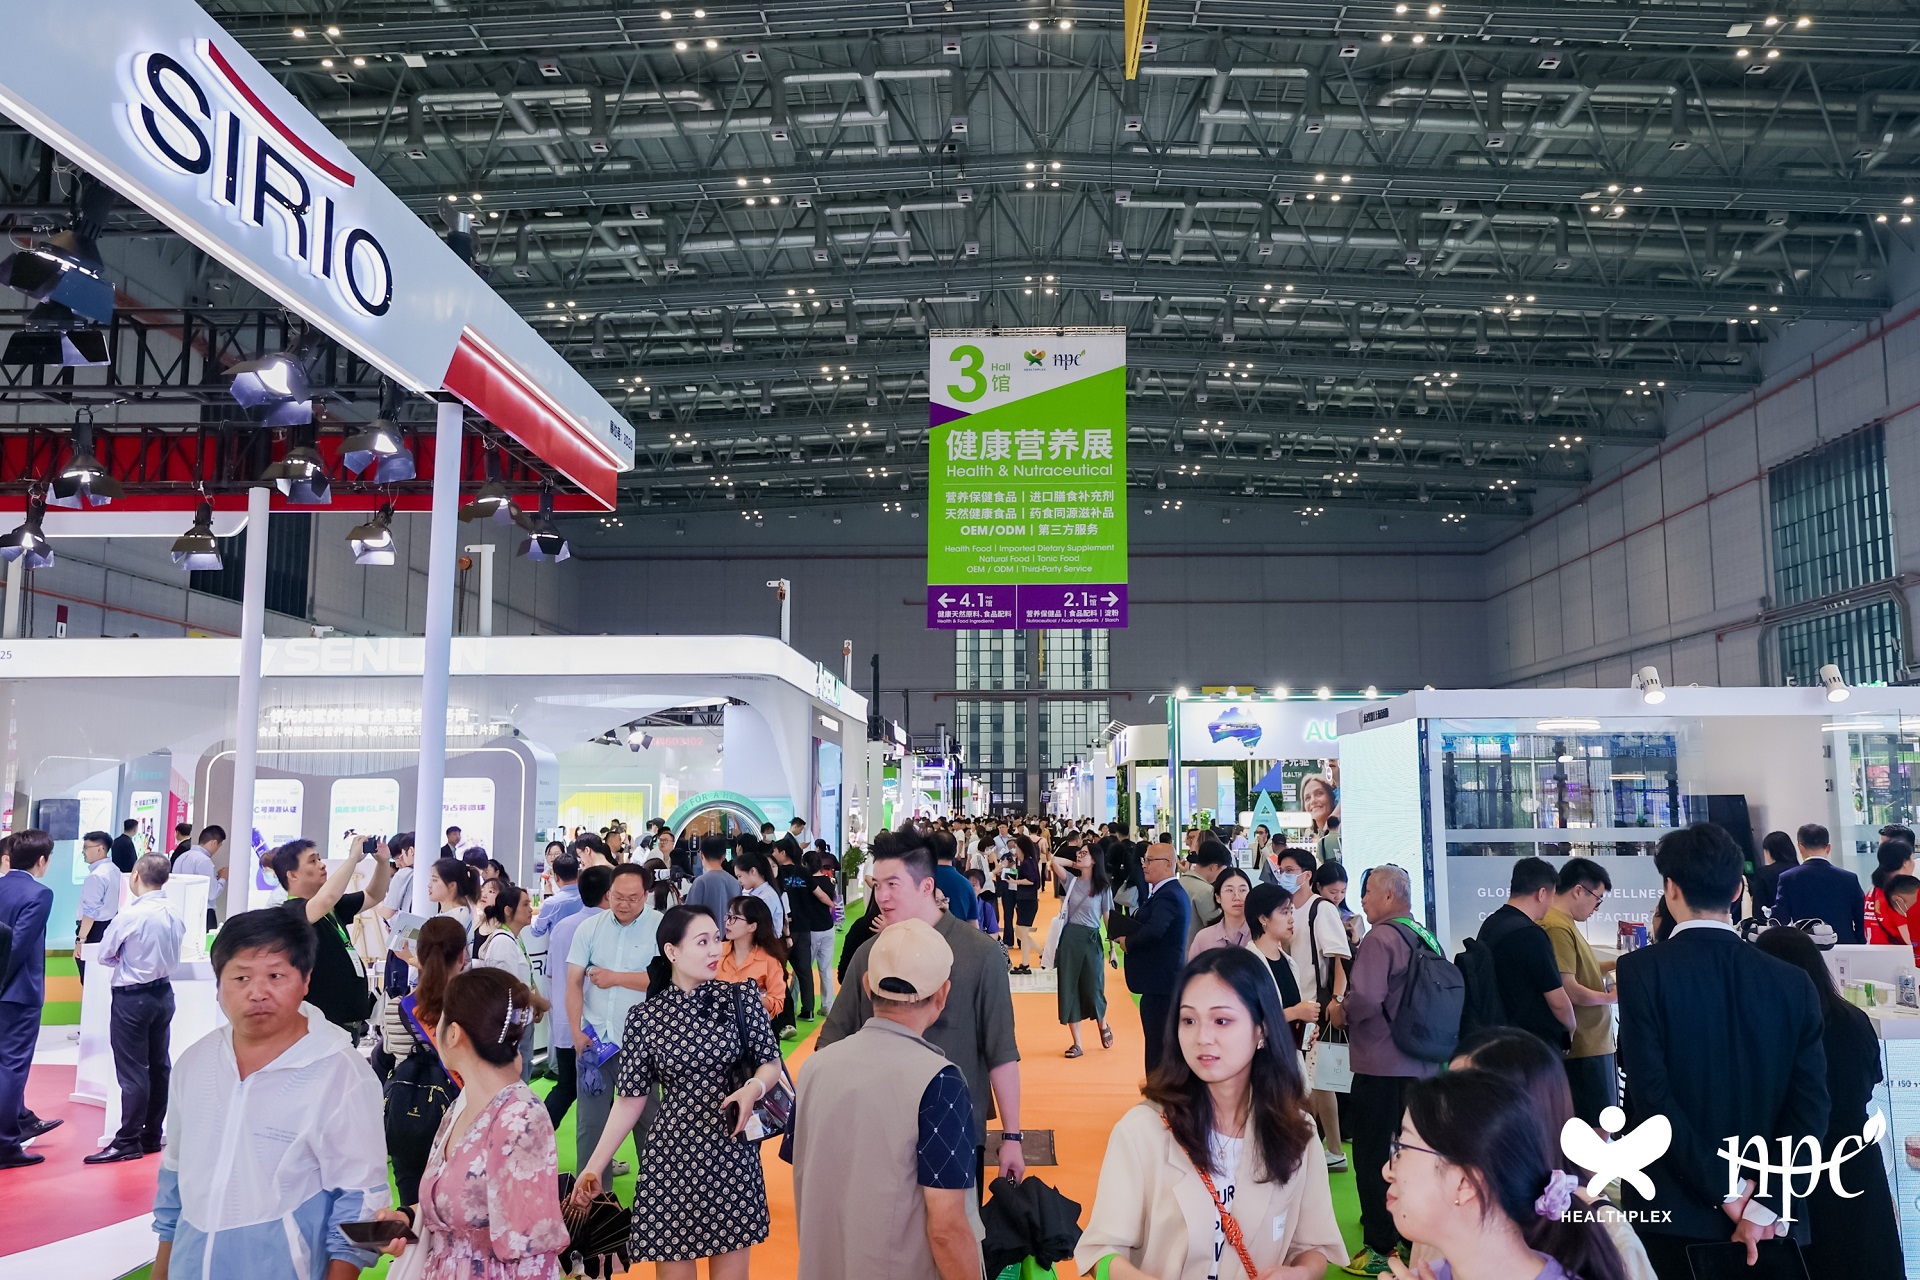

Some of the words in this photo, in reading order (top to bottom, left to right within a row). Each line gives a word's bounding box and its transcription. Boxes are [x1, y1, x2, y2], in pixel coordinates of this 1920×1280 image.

[132, 50, 393, 318] SIRIO
[946, 344, 988, 403] 3
[991, 362, 1011, 372] Hall
[991, 374, 1011, 393] 馆
[946, 428, 1113, 461] 健康营养展
[946, 465, 994, 477] Health
[998, 465, 1009, 477] &
[1013, 464, 1113, 477] Nutraceutical
[945, 491, 1017, 503] 营养保健食品
[1029, 490, 1114, 503] 进口膳食补充剂
[945, 507, 1017, 520] 天然健康食品
[1029, 507, 1114, 519] 药食同源滋补品
[960, 525, 1026, 536] OEM/ODM
[1038, 523, 1099, 536] 第三方服务
[944, 545, 969, 553] Health
[972, 545, 992, 553] Food
[999, 545, 1035, 553] Imported
[1037, 545, 1065, 553] Dietary
[1067, 544, 1115, 553] Supplement
[979, 555, 1008, 563] Natural
[1010, 555, 1030, 563] Food
[1037, 555, 1058, 563] Tonic
[966, 565, 985, 573] OEM
[993, 565, 1014, 573] ODM
[1021, 565, 1062, 574] Third-Party
[1063, 564, 1093, 573] Service
[959, 592, 984, 608] 4.1
[1063, 591, 1088, 607] 2.1
[283, 637, 487, 673] SENLN
